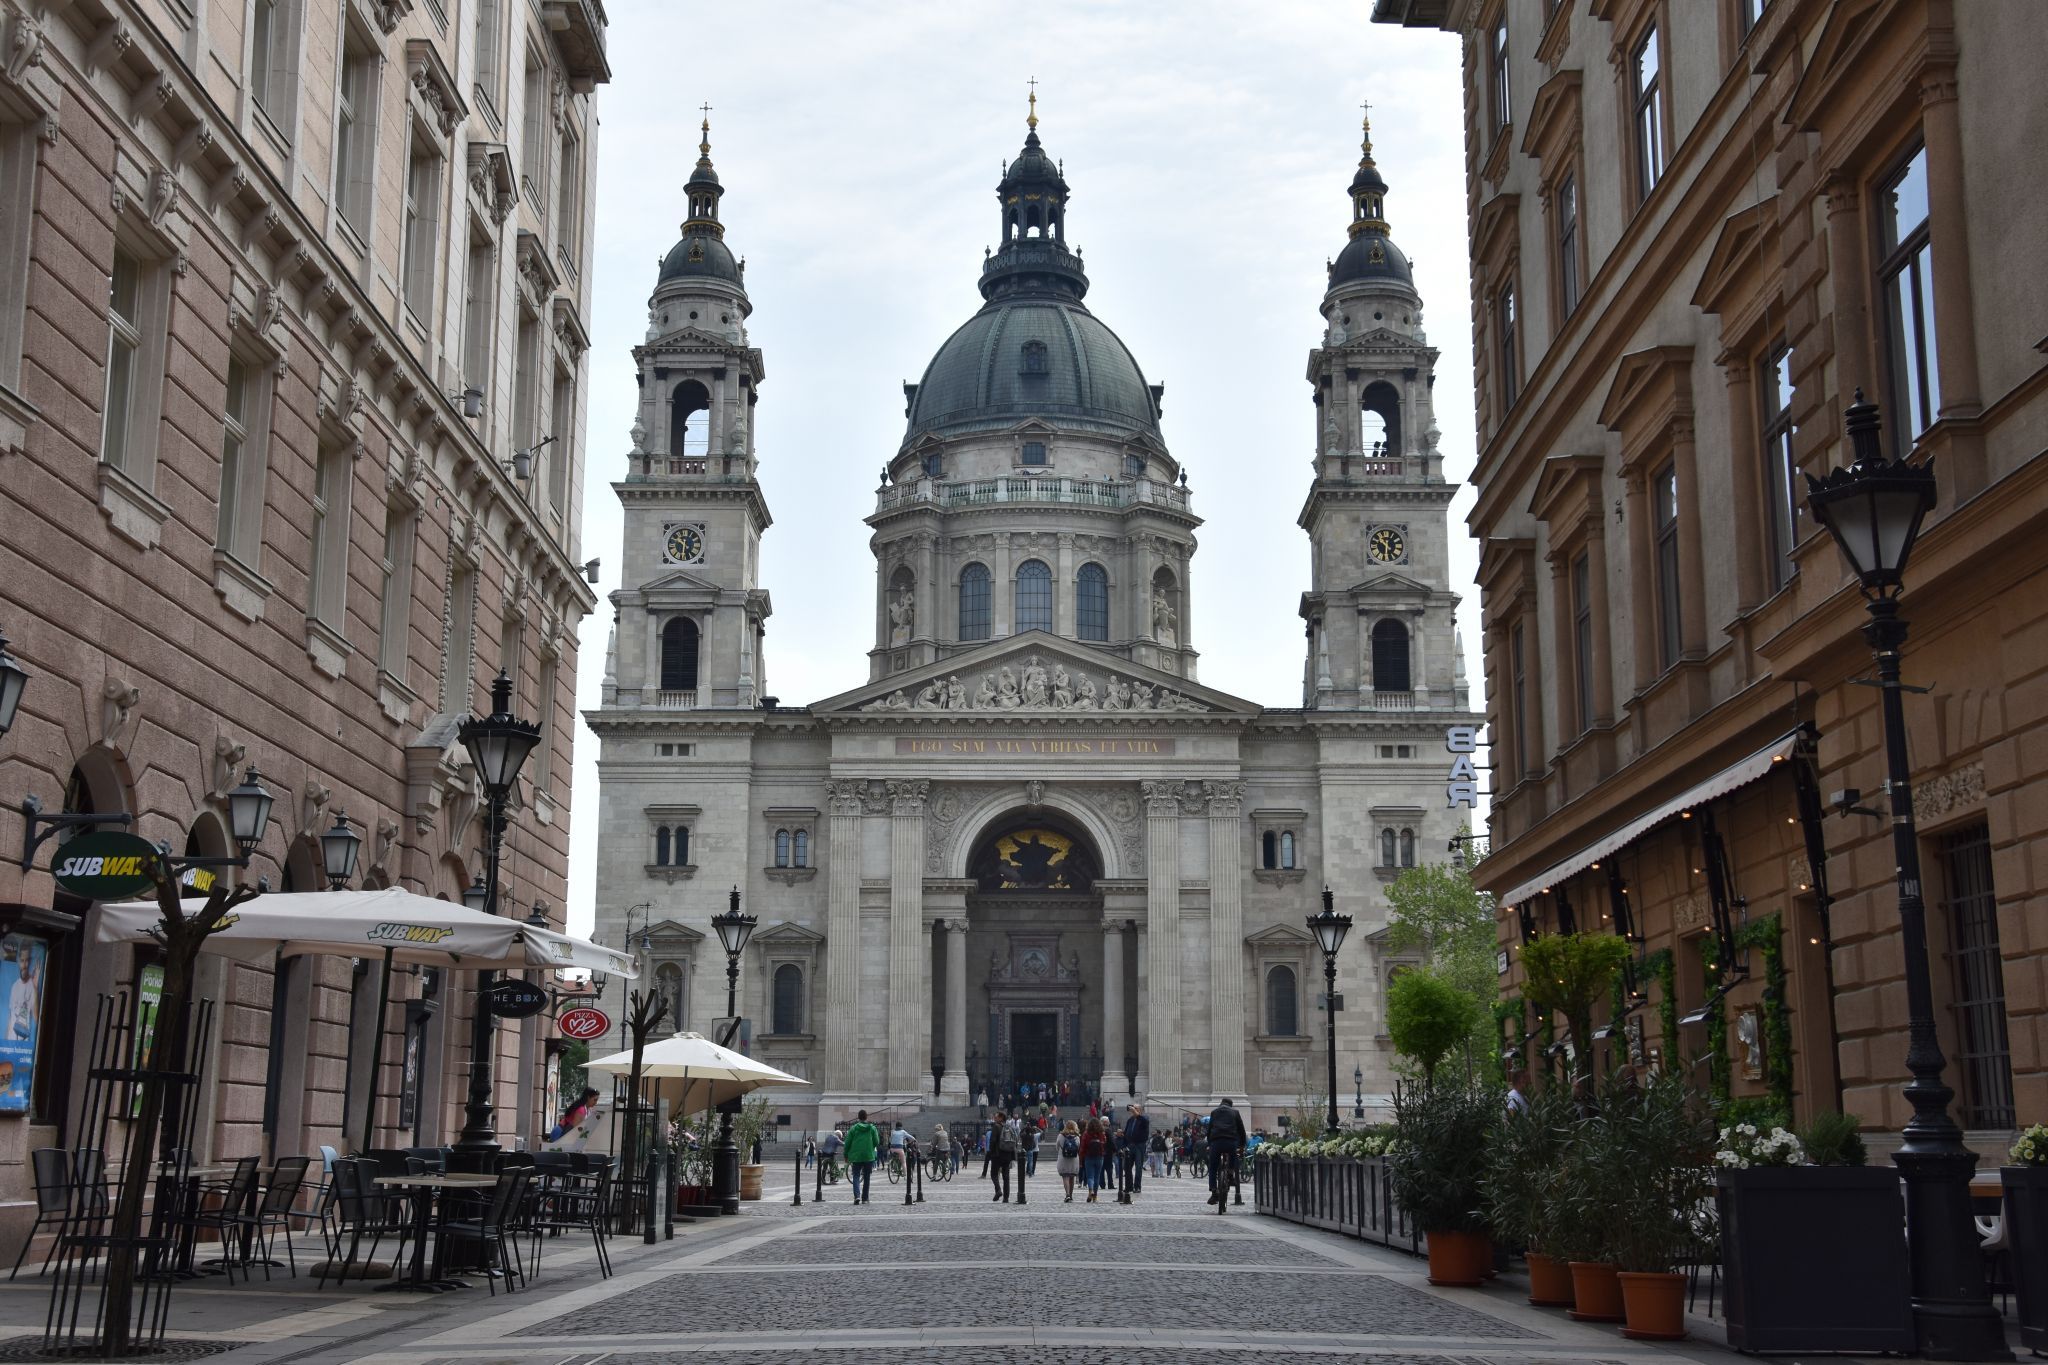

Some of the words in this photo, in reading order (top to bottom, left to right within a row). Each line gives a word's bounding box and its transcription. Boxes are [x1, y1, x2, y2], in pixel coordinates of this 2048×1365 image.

[911, 740, 942, 753] EGO
[952, 740, 985, 753] SUM
[995, 740, 1022, 753] VIA
[1031, 740, 1092, 753] VERITAS
[1100, 740, 1118, 753] ET
[1127, 740, 1159, 753] VITA
[182, 867, 216, 892] UBWAY
[367, 922, 454, 943] SUBWAY
[493, 994, 508, 1002] HE
